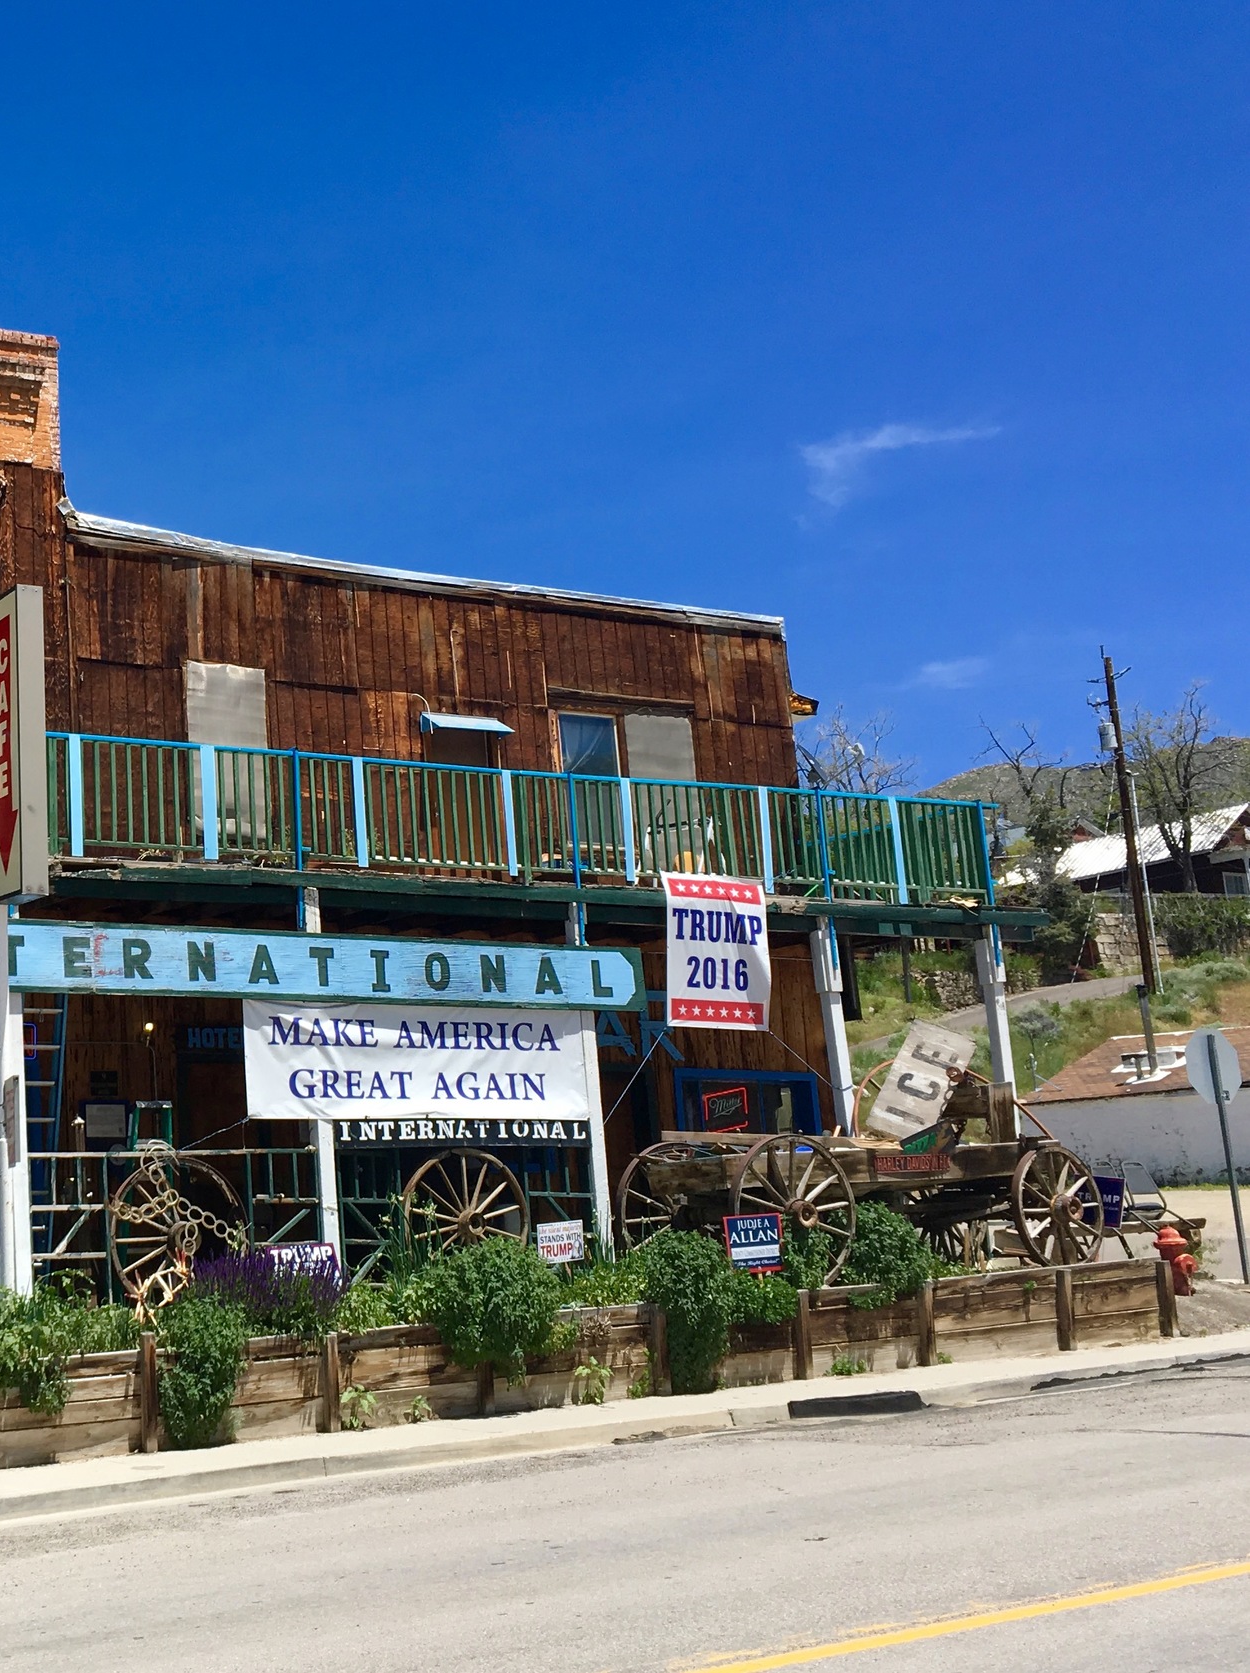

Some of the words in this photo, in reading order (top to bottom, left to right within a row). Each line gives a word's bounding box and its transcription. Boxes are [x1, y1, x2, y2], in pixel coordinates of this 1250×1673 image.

[672, 907, 763, 946] TRUMP
[686, 955, 749, 992] 2016
[267, 1015, 379, 1047] MAKE
[393, 1020, 561, 1052] AMERICA
[288, 1068, 412, 1100] GREAT
[430, 1071, 546, 1101] AGAIN
[885, 1041, 959, 1126] ICE
[339, 1119, 586, 1142] INTERNATIONAL
[877, 1157, 905, 1172] HARLEY
[1077, 1191, 1120, 1204] TRMP
[540, 1234, 565, 1244] STANDS
[566, 1232, 581, 1241] WITH
[730, 1228, 778, 1244] ALLAN
[540, 1242, 573, 1258] TRUMP
